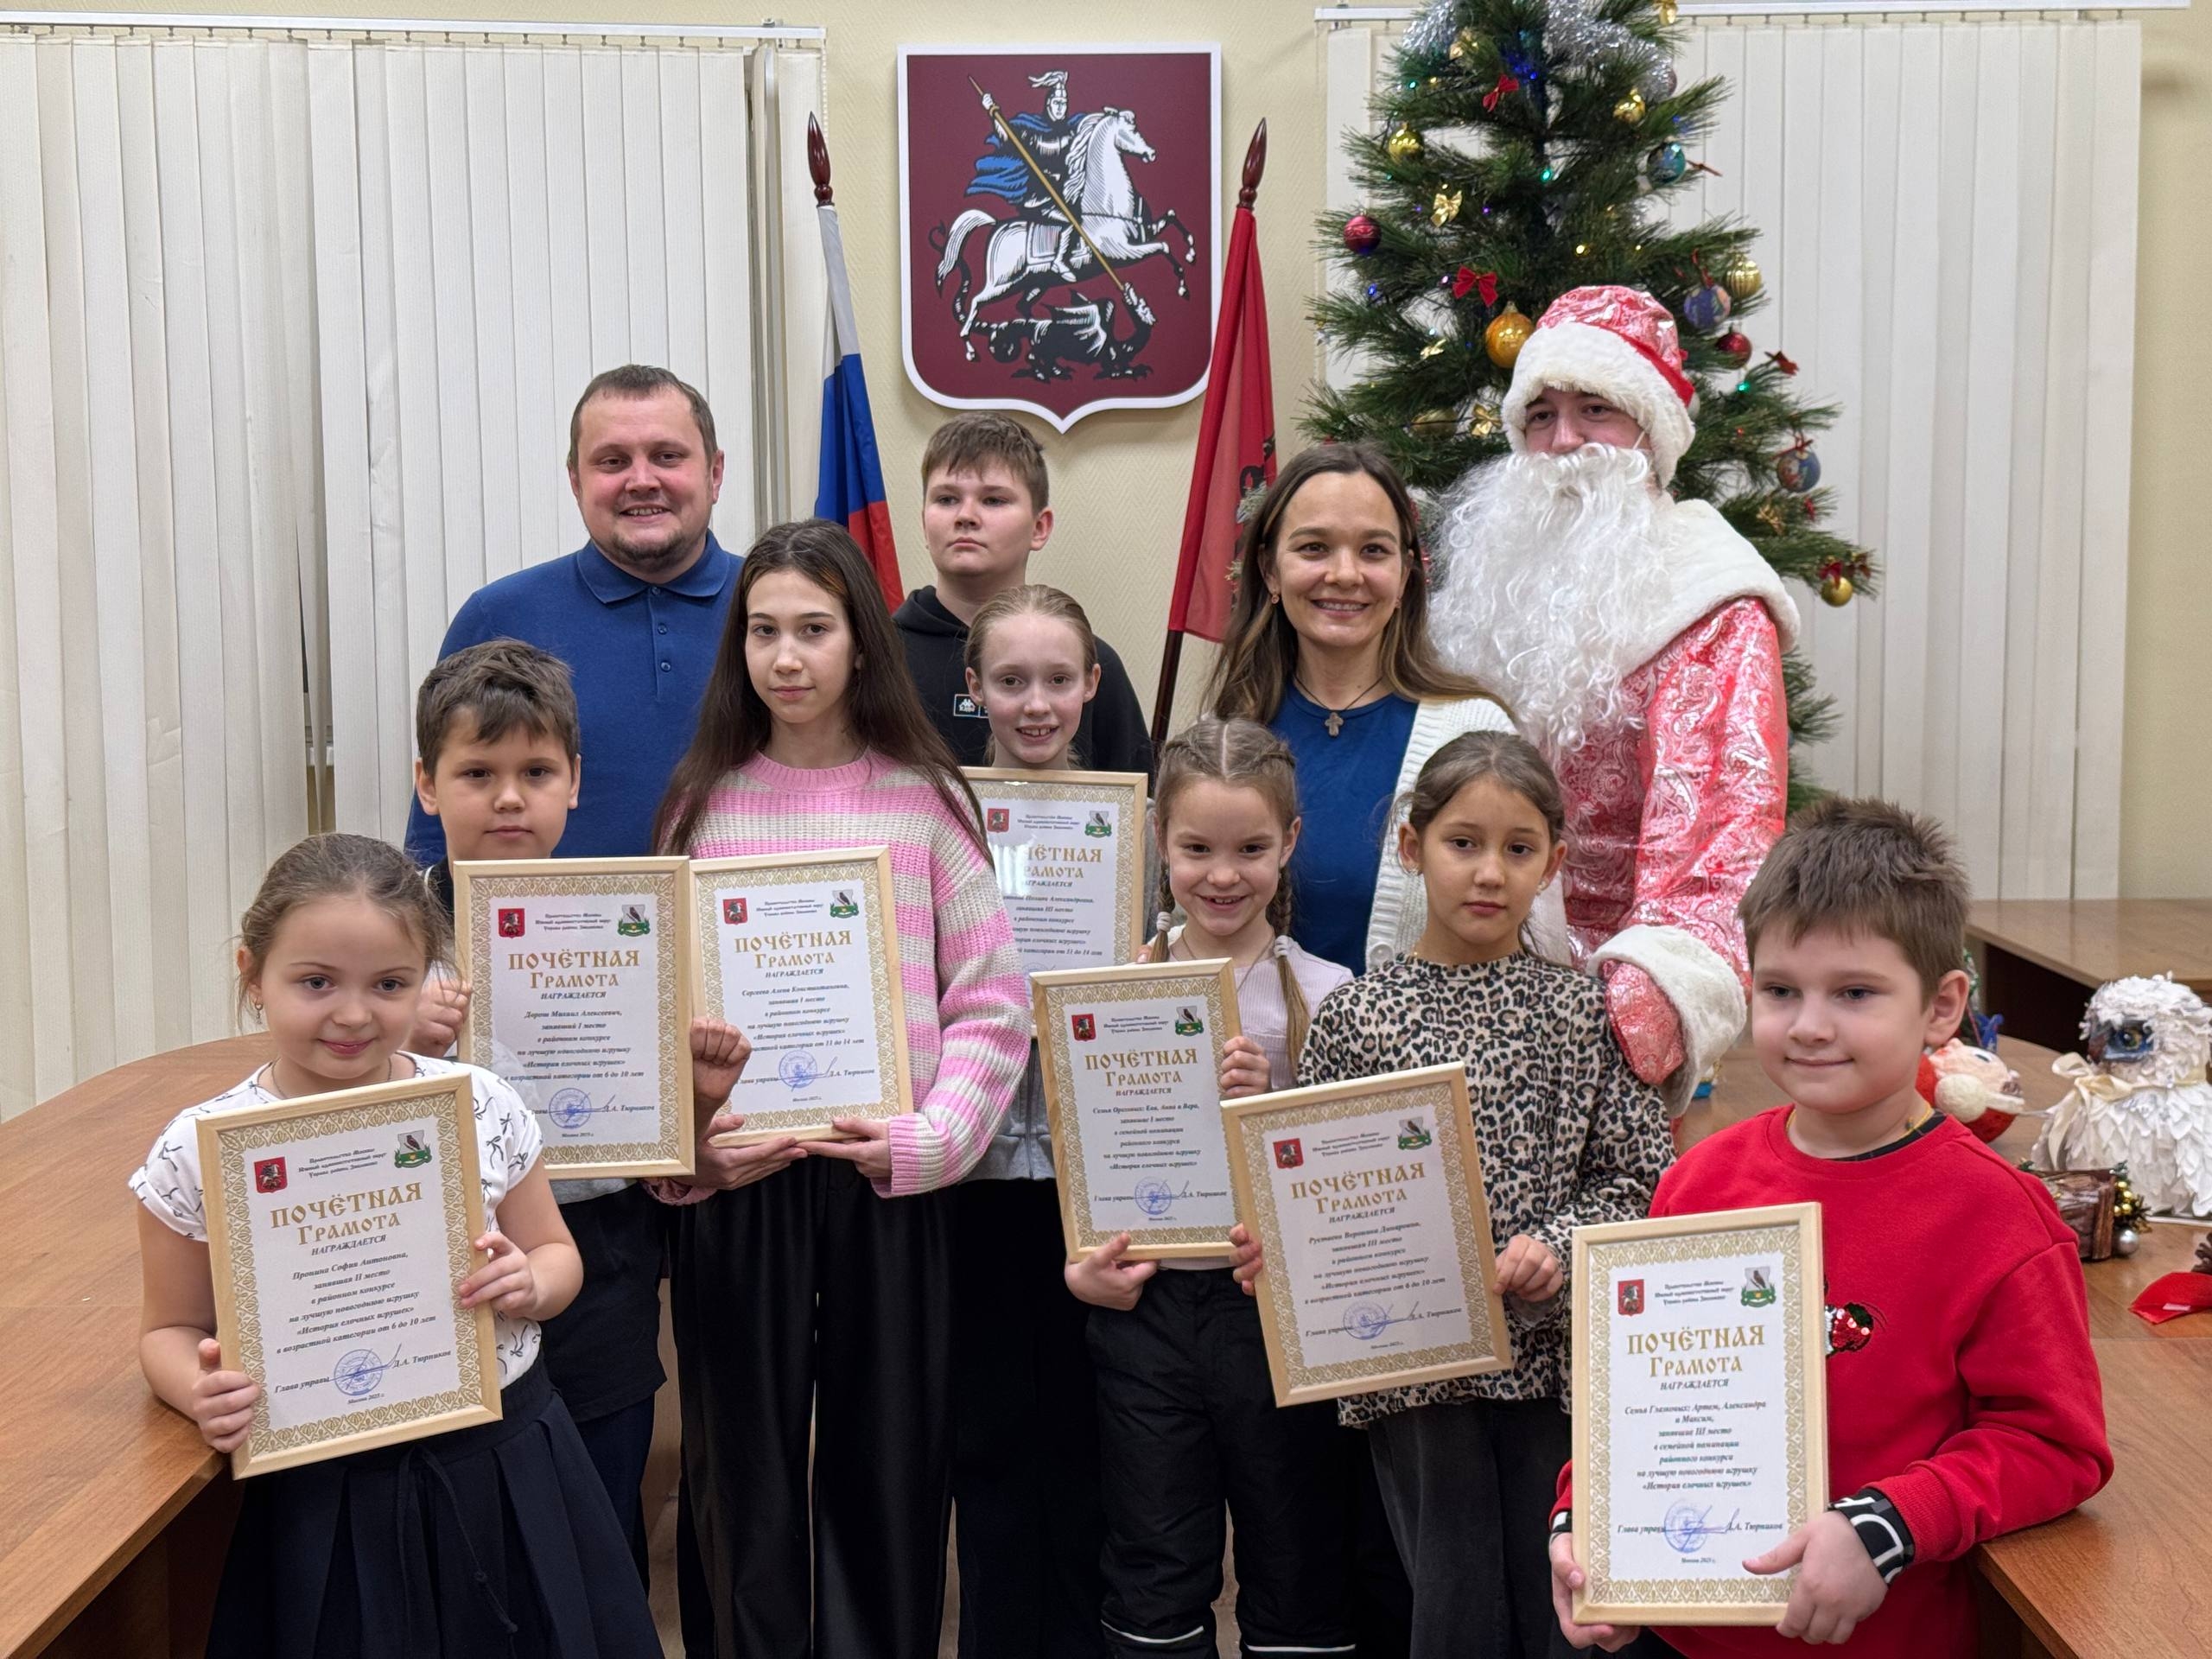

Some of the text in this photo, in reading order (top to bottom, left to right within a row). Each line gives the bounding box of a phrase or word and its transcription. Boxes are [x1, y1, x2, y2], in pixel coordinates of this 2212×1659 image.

[735, 931, 850, 952] ПОЧЁТНАЯ
[509, 949, 639, 969] ПОЧЁТНАЯ
[766, 968, 823, 978] НАГРАЖДАЕТСЯ
[541, 991, 606, 1000] НАГРАЖДАЕТСЯ
[1085, 1048, 1197, 1070] ПОЧЁТНАЯ
[1292, 1162, 1424, 1198] ПОЧЁТНАЯ
[271, 1183, 421, 1228] ПОЧЁТНАЯ
[1329, 1206, 1395, 1223] НАГРАЖДАЕТСЯ
[311, 1234, 386, 1255] НАГРАЖДАЕТСЯ
[1629, 1325, 1763, 1354] ПОЧЁТНАЯ
[1660, 1378, 1729, 1390] НАГРАЖДАЕТСЯ
